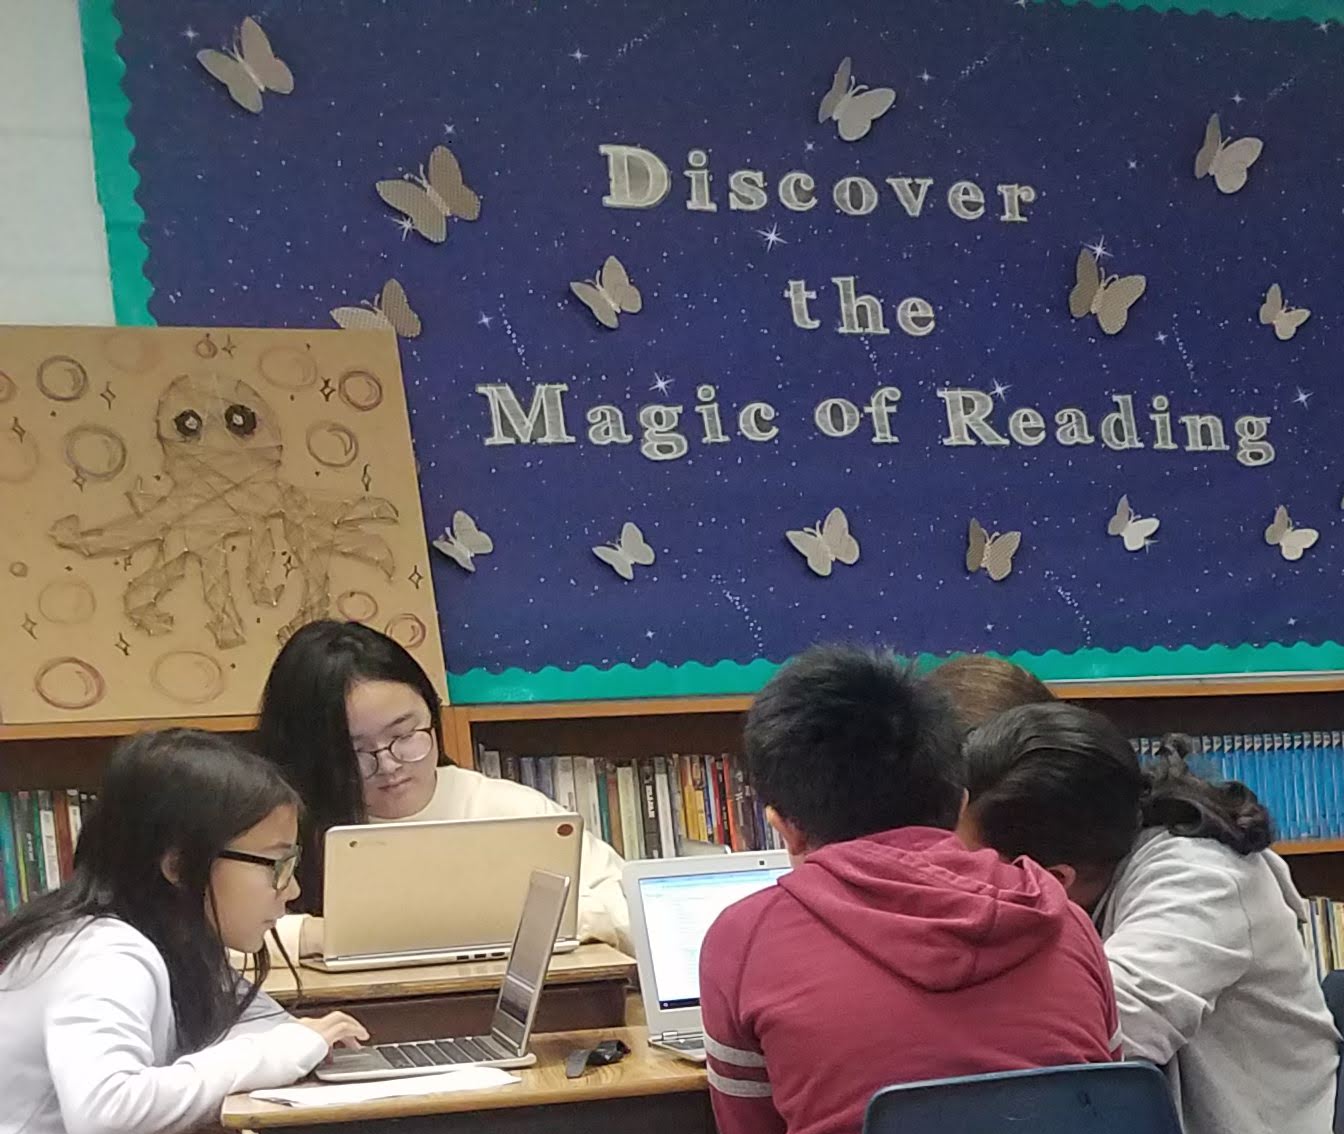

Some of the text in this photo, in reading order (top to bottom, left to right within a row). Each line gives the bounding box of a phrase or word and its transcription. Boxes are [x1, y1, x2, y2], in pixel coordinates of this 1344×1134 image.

[600, 143, 1039, 223] Discover
[786, 276, 937, 337] the
[477, 383, 1277, 467] Magic of Reading
